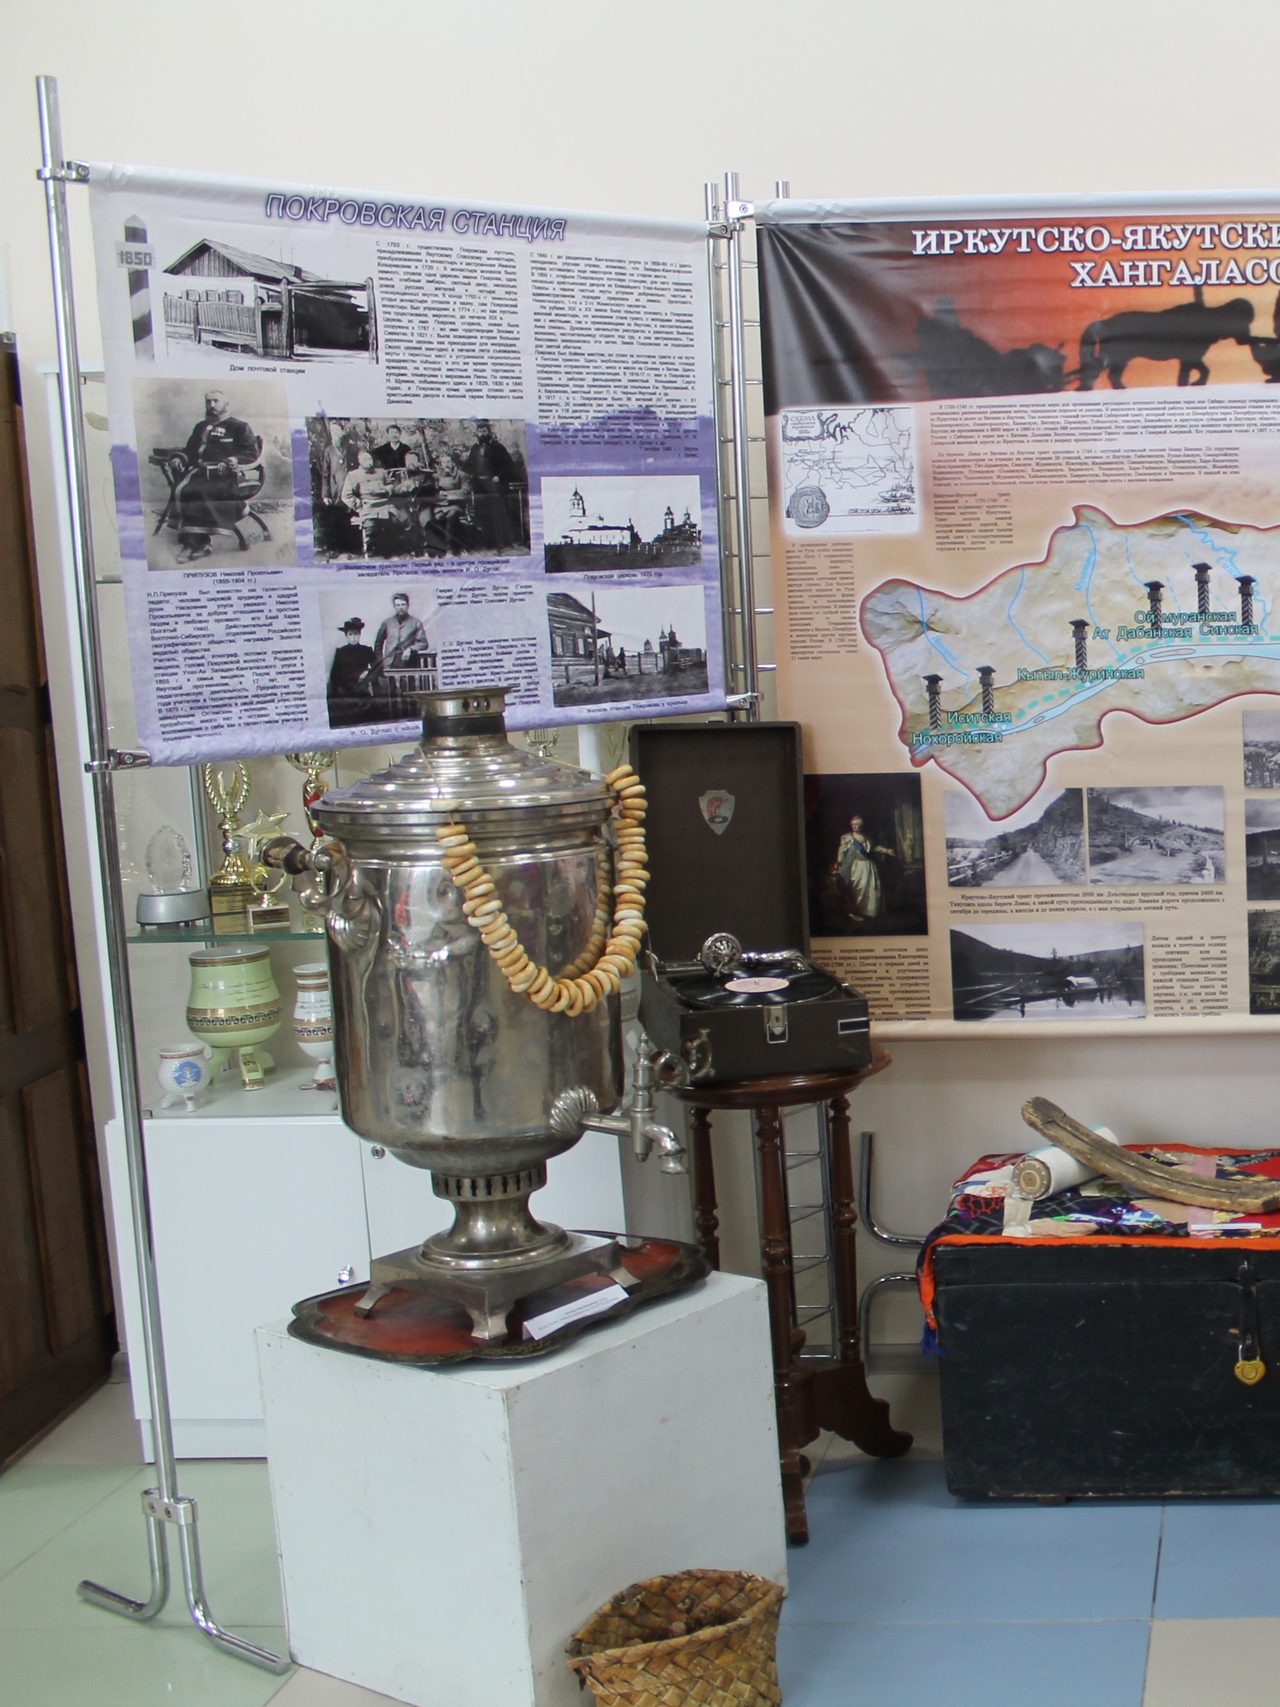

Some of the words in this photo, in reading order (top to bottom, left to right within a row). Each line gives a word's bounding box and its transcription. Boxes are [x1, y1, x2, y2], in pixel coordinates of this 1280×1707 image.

[266, 193, 446, 232] ПОКРОВСКАЯ
[452, 210, 567, 242] СТАНЦИЯ
[119, 250, 153, 267] 1850
[229, 364, 245, 373] Дом
[247, 365, 278, 375] почтовой
[279, 366, 306, 375] станции
[584, 573, 614, 581] Покровская
[1134, 610, 1157, 624] Ой
[1162, 611, 1237, 625] муранская
[1093, 627, 1110, 639] Ат
[1116, 626, 1192, 641] Дабанская
[1200, 622, 1258, 636] Синская
[1017, 667, 1145, 682] Кытыл-Журинская
[948, 710, 1012, 724] Иситская
[913, 731, 1003, 746] Нохоройская
